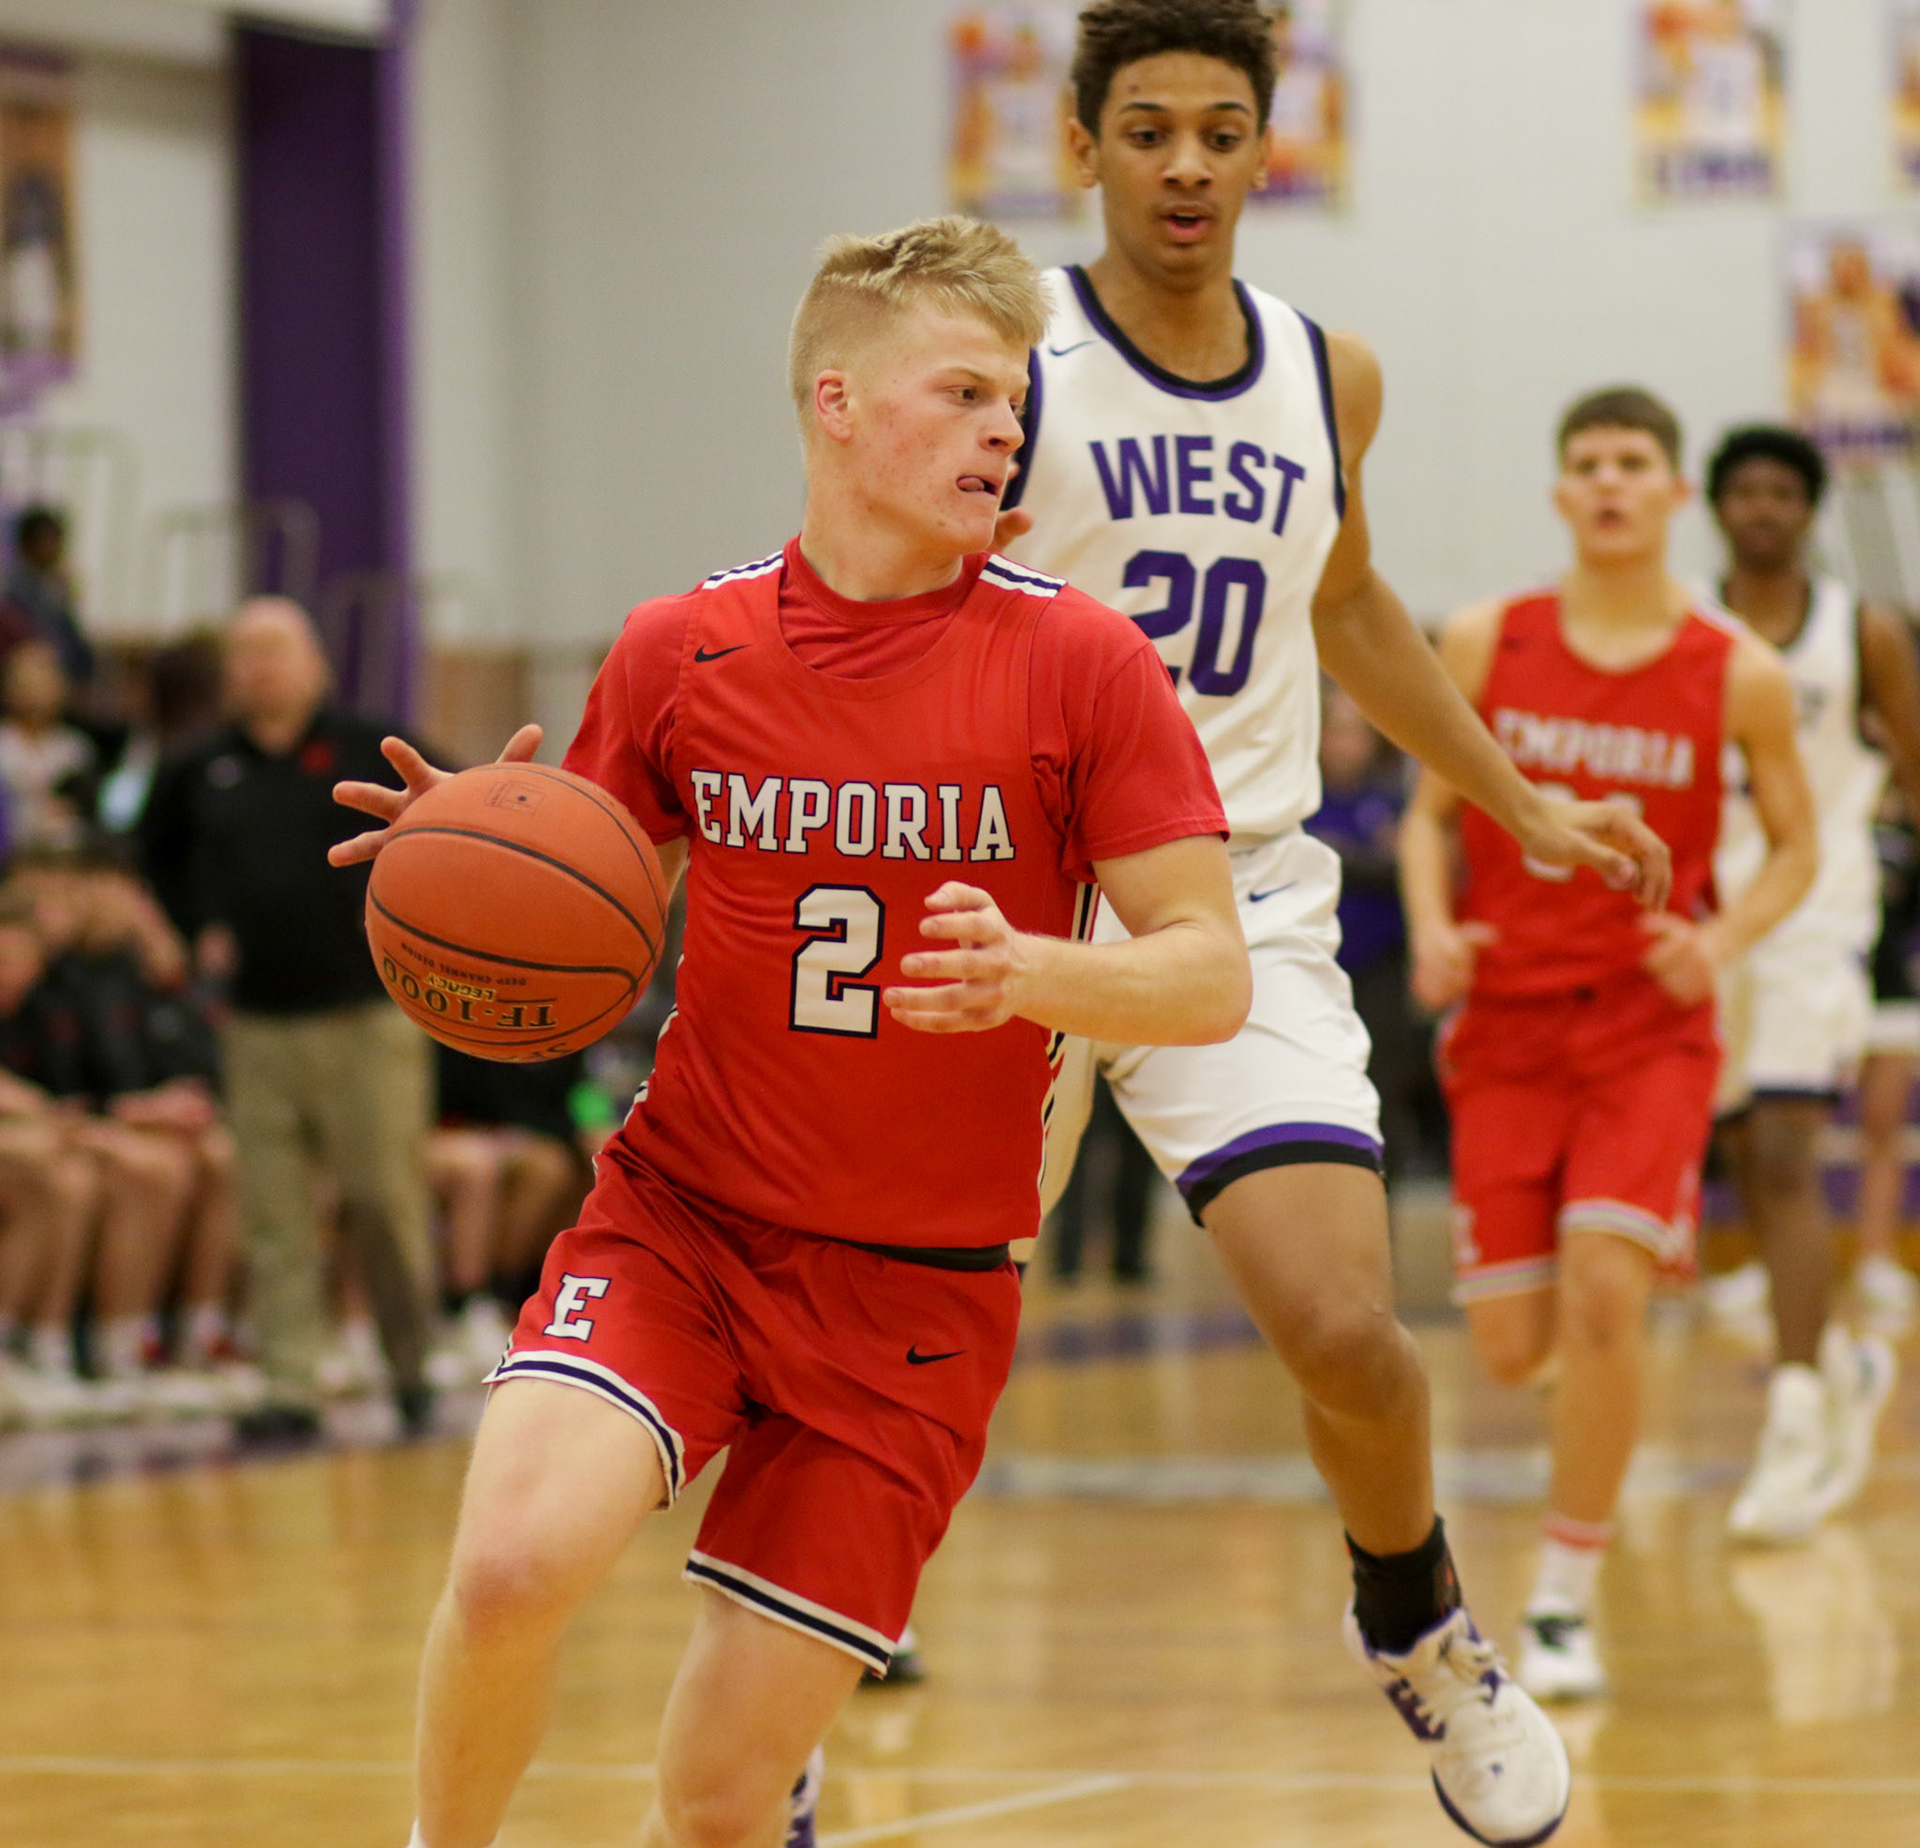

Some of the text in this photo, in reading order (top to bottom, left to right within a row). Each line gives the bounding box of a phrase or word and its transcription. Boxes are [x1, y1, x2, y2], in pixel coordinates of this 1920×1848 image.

[1088, 434, 1306, 538] WEST
[1122, 549, 1267, 697] 20
[690, 768, 1016, 863] EMPORIA
[382, 956, 558, 1029] TF-1000
[423, 971, 496, 1003] LEGACY
[788, 883, 886, 1040] 2
[542, 1271, 613, 1343] E
